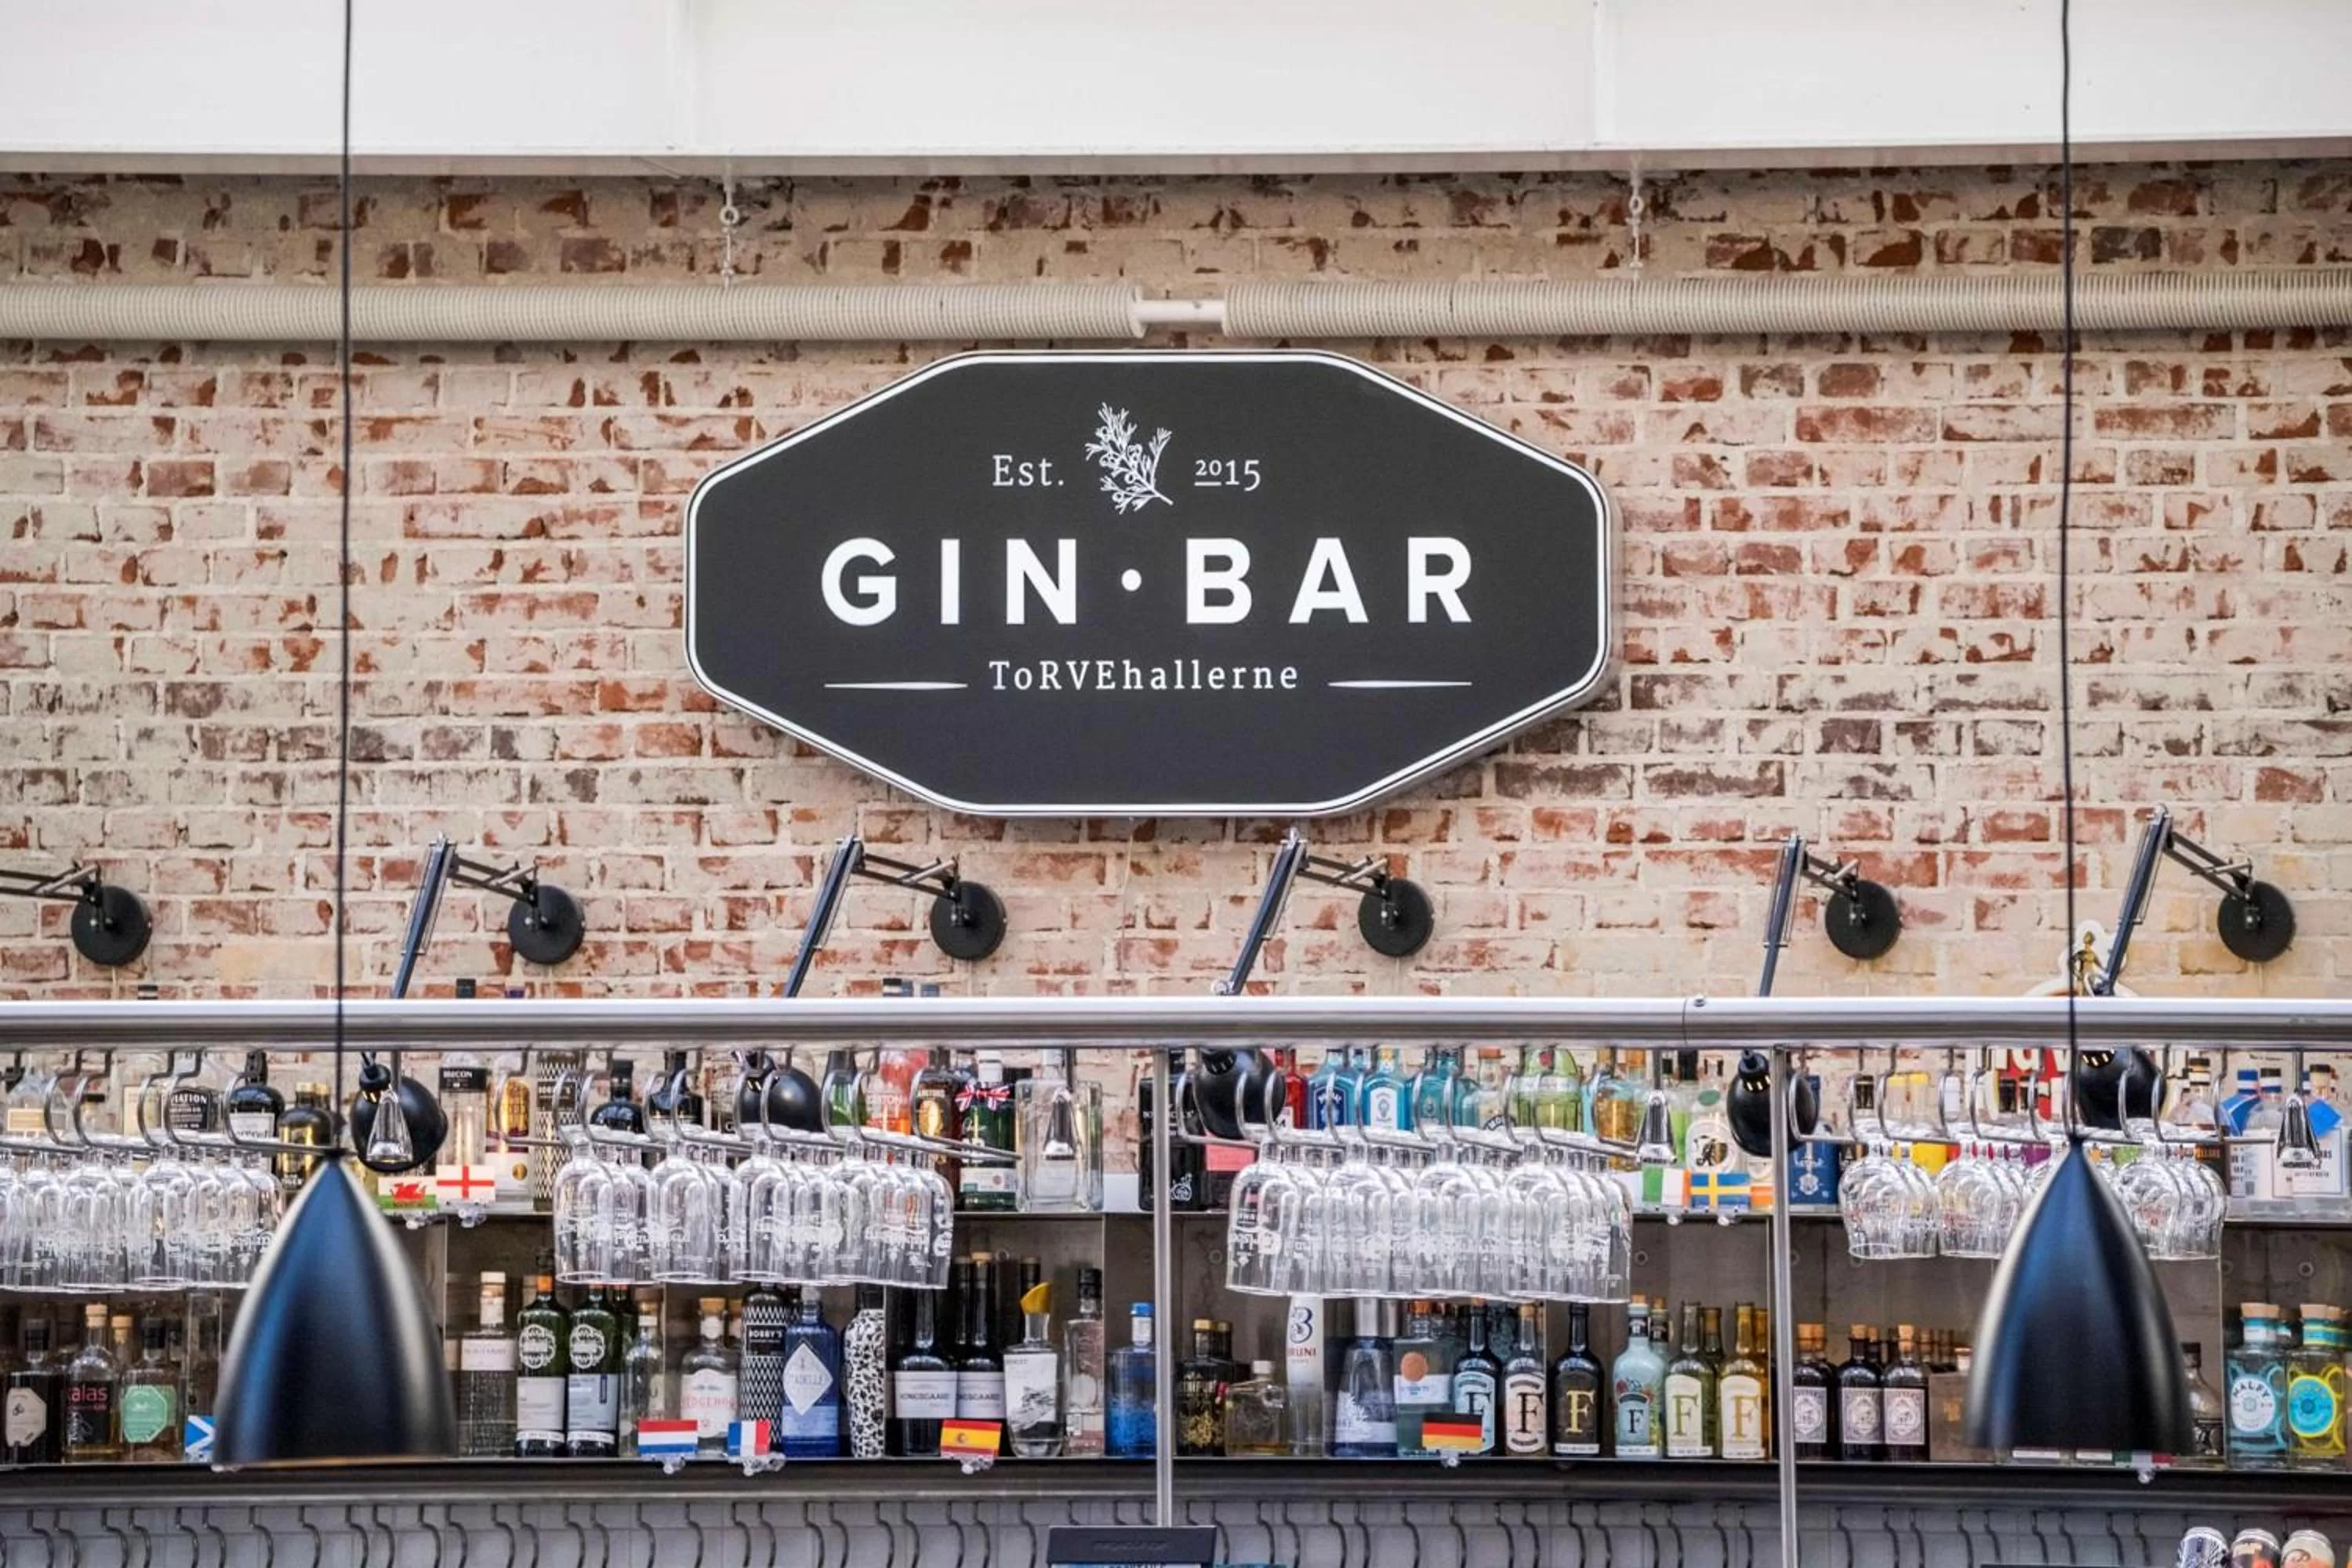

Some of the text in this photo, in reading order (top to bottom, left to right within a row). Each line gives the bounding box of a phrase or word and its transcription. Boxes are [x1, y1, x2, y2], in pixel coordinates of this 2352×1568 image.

[992, 456, 1262, 492] Est. 2015
[821, 537, 1473, 627] GIN BAR
[989, 659, 1298, 693] ToRVEhallerne
[1517, 1392, 1544, 1434] F
[1566, 1389, 1595, 1434] F
[1629, 1409, 1644, 1434] F
[1672, 1394, 1700, 1436] F
[1731, 1395, 1760, 1438] F
